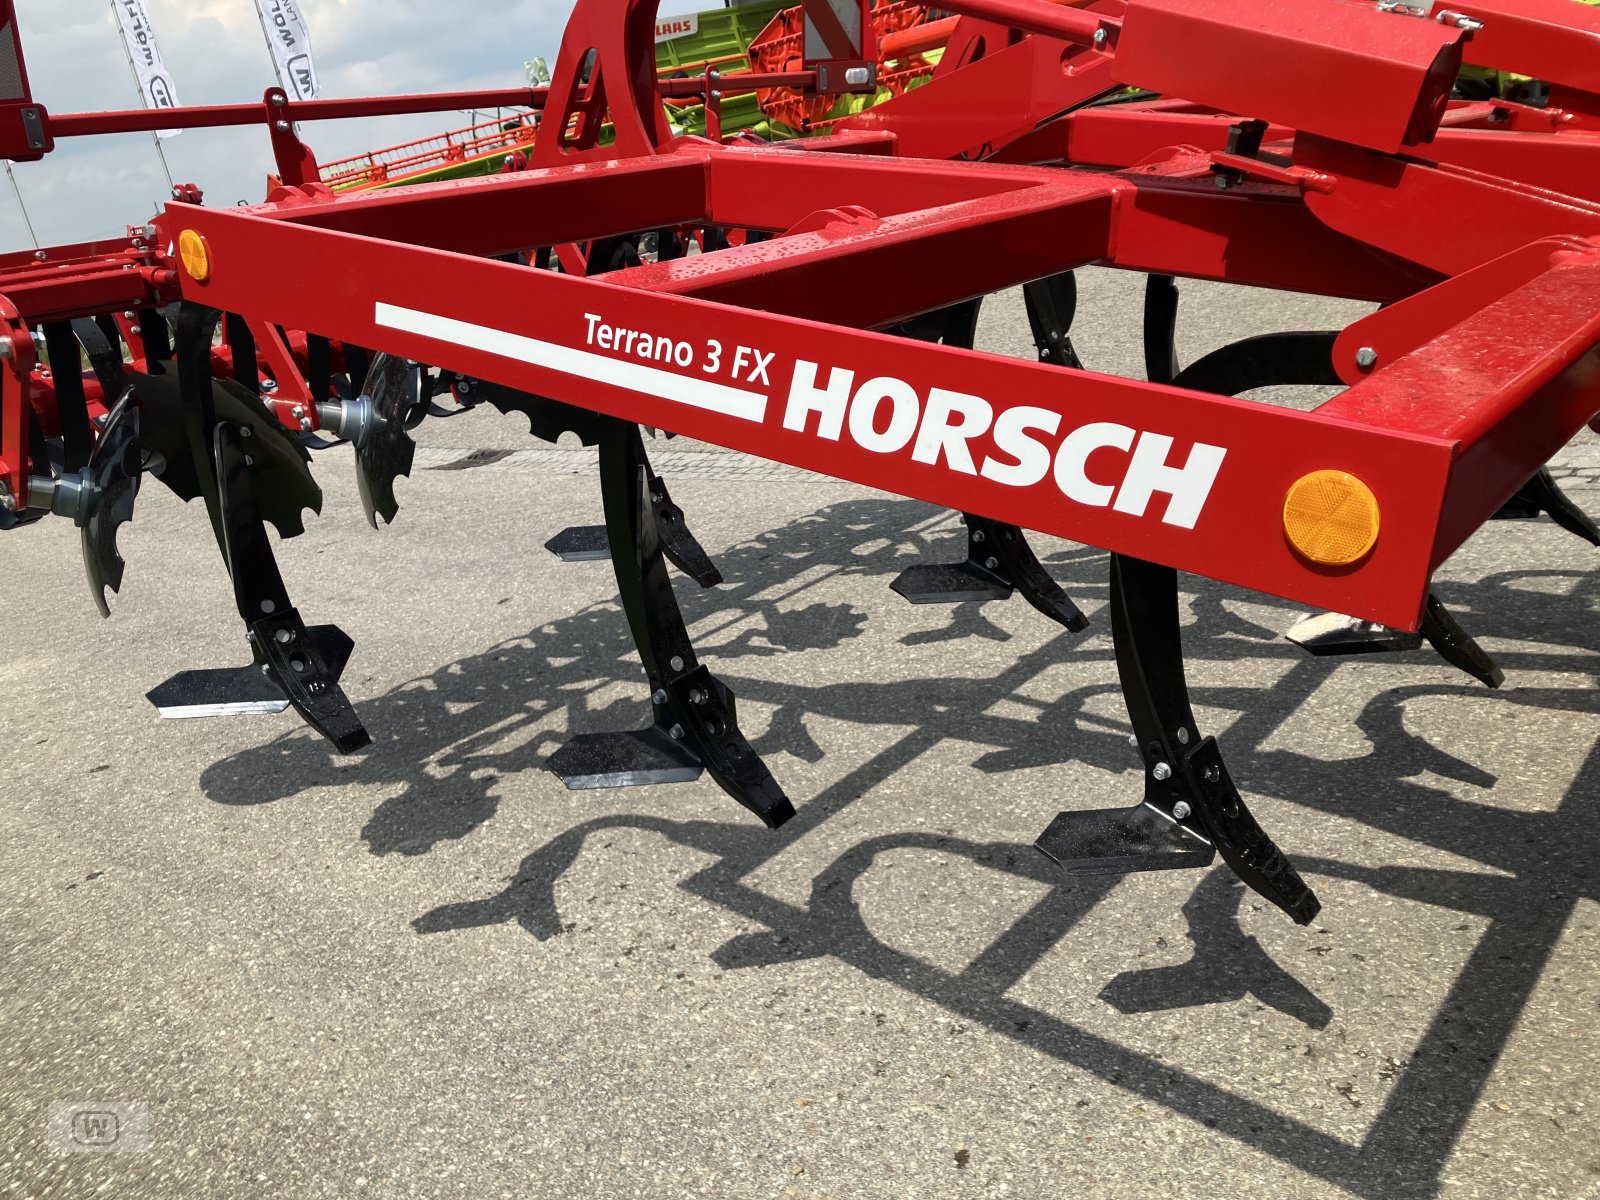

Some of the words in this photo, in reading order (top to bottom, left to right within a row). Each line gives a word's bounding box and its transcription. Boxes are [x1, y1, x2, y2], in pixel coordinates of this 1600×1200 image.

[584, 312, 694, 367] Terrano
[702, 339, 722, 373] 3
[731, 345, 776, 387] FX
[783, 359, 1228, 530] HORSCH
